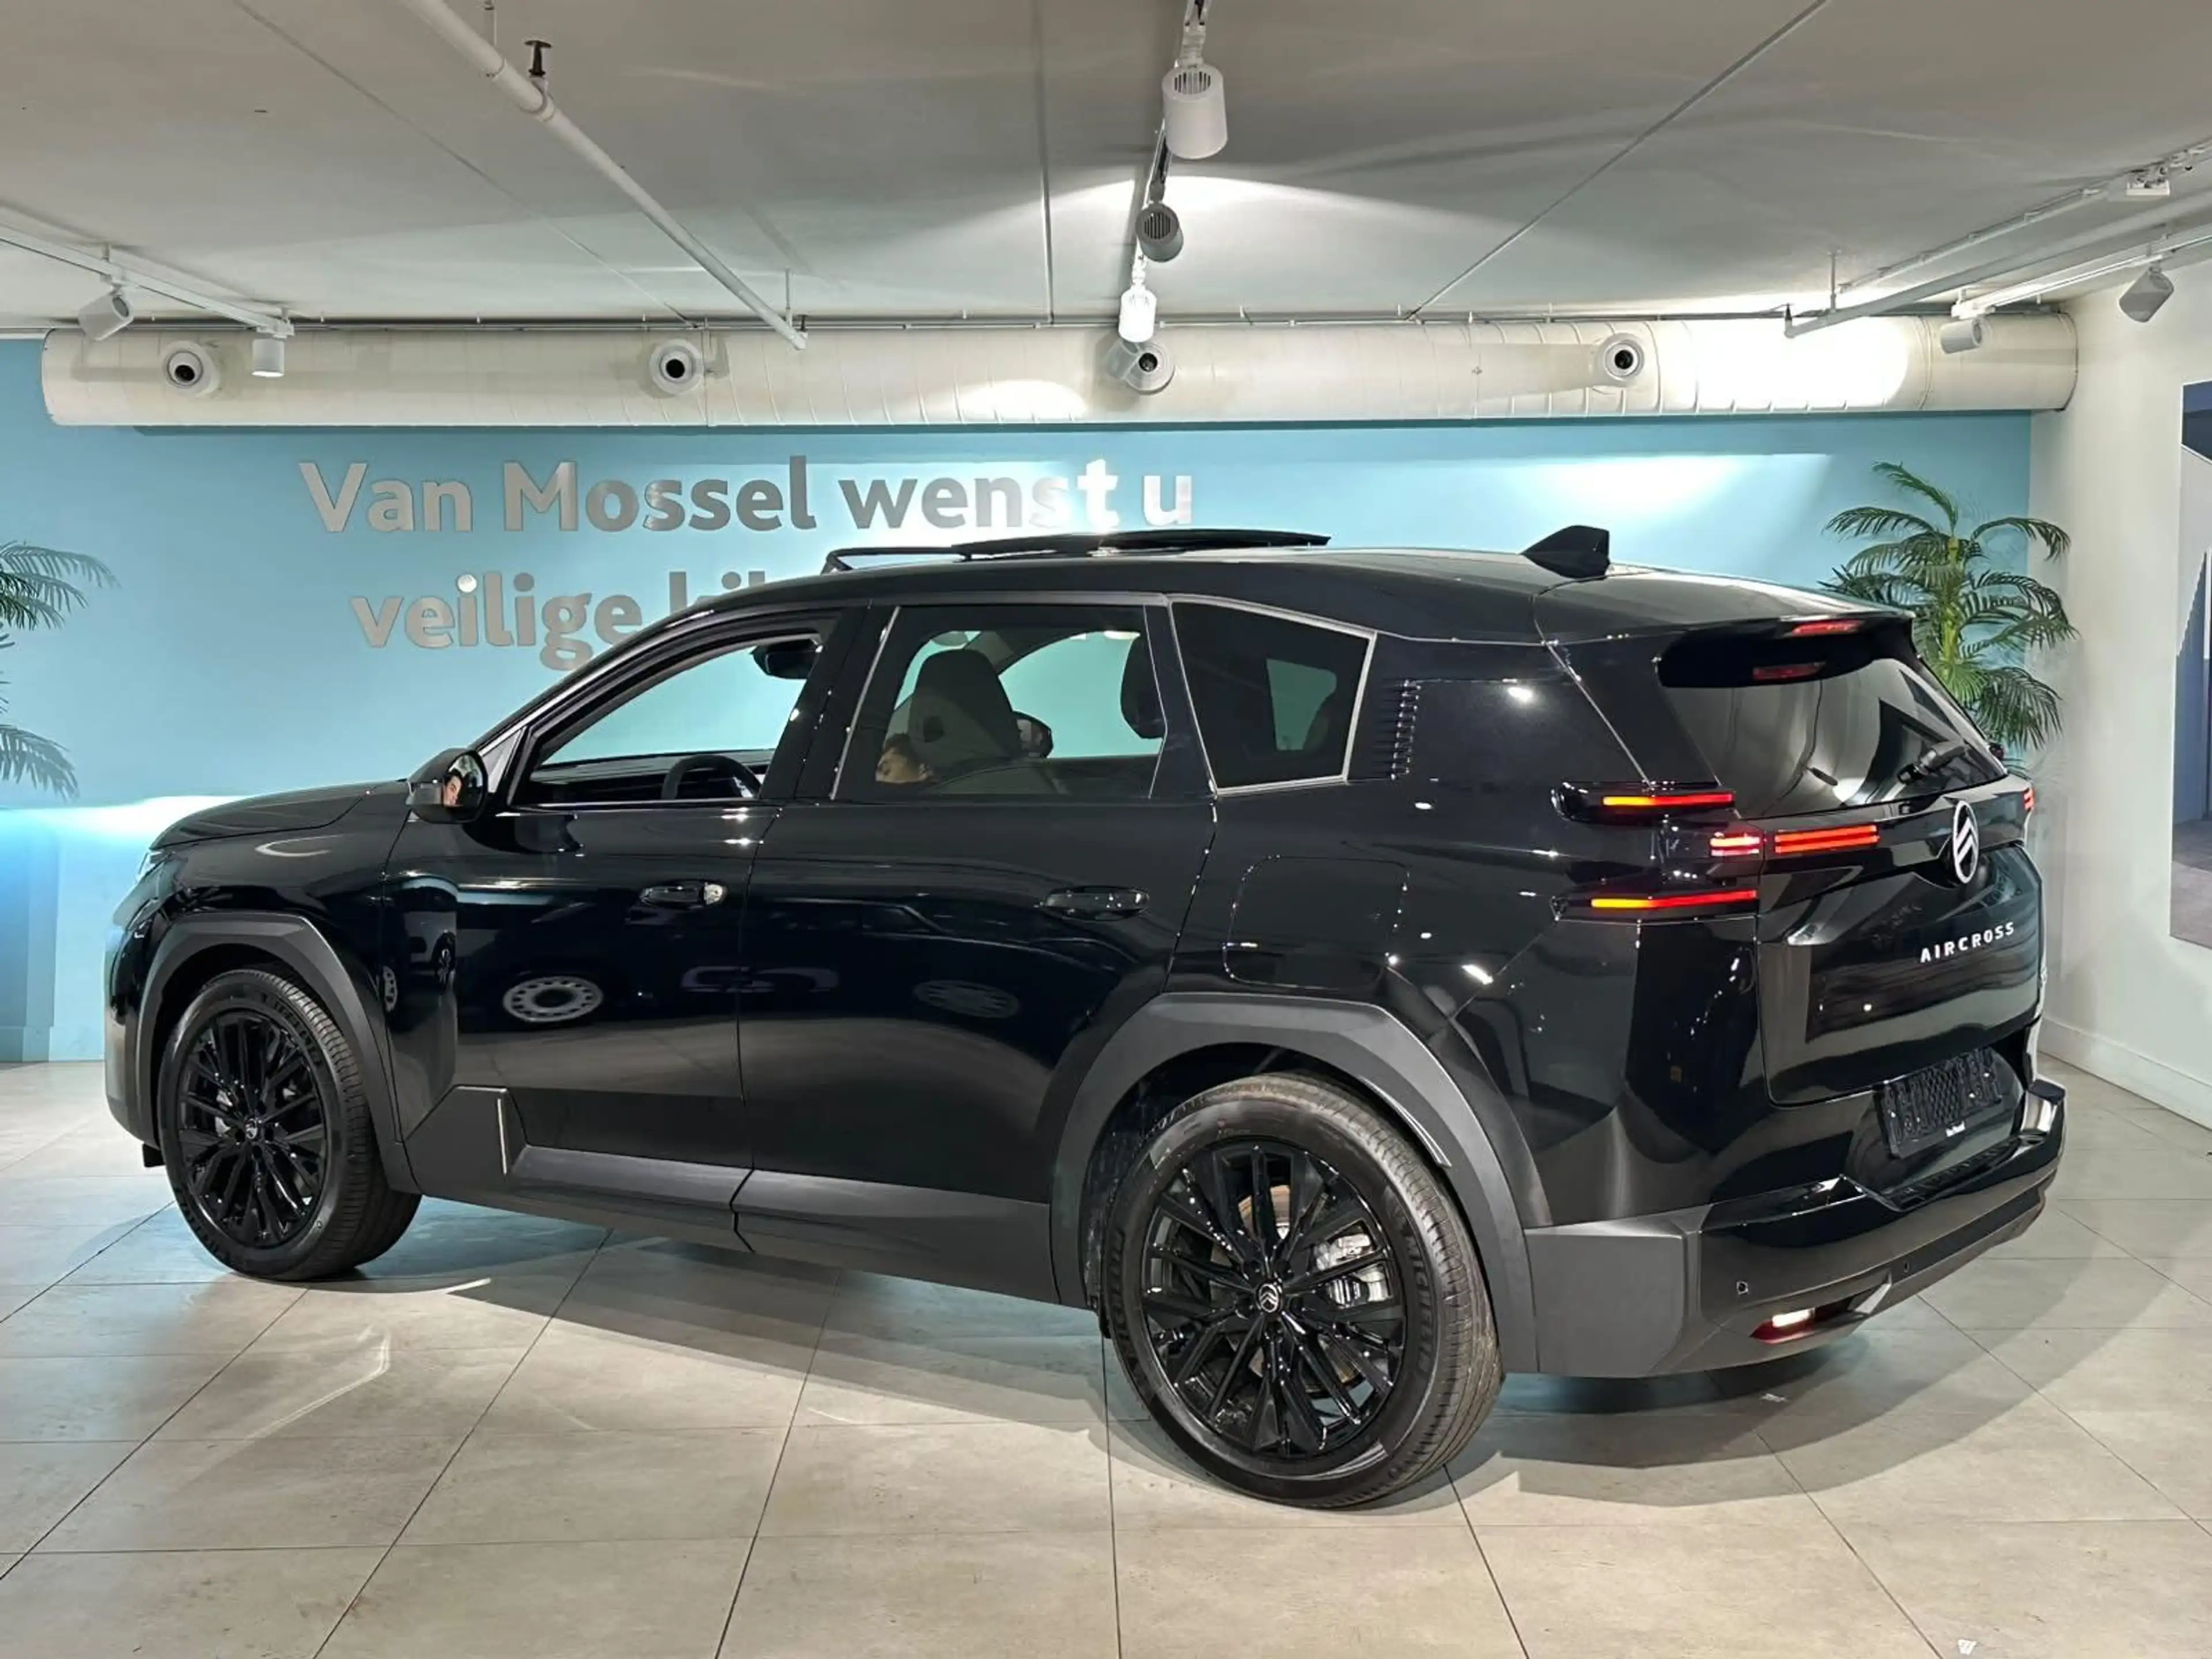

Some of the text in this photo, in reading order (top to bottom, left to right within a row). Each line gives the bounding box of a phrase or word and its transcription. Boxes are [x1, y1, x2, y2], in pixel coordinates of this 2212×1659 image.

[299, 454, 1192, 533] Van Mossel wenst u
[350, 571, 643, 671] veilige
[1920, 921, 2014, 963] AIRCROSS
